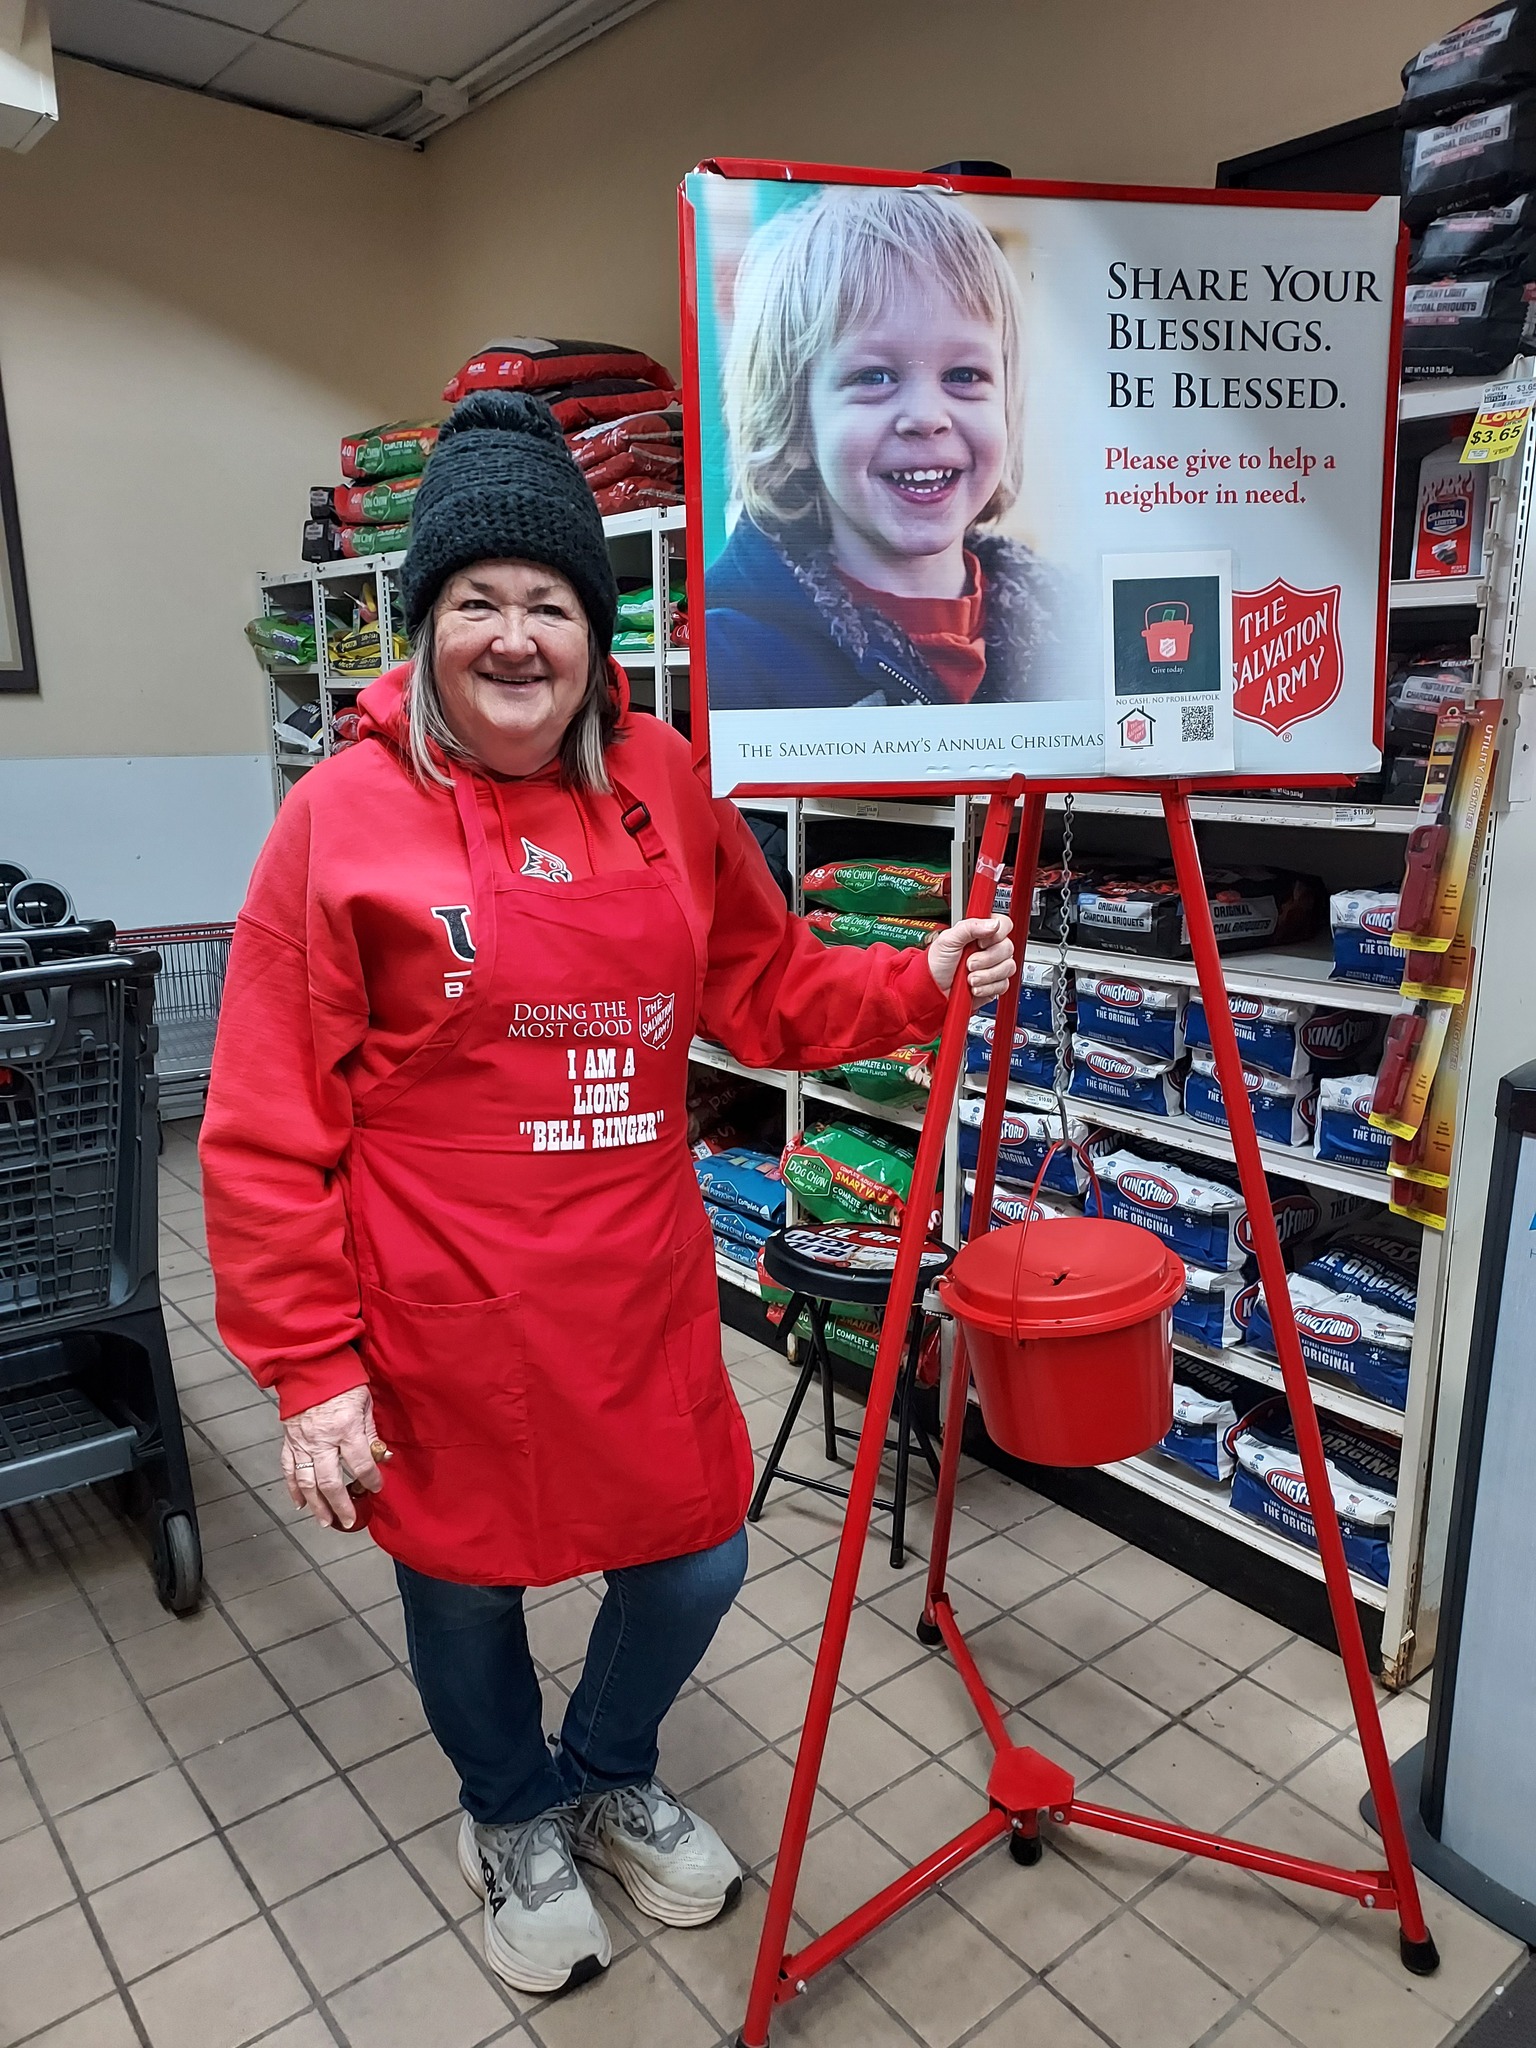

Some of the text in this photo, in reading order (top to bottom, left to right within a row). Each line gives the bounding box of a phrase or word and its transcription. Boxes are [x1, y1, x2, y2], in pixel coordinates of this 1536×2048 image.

[1107, 261, 1383, 303] SHARE YOUR
[1107, 312, 1331, 352] BLESSINGS.
[1107, 371, 1346, 410] BE BLESSED.
[1480, 408, 1527, 424] LOW
[1470, 425, 1522, 446] $3.65
[1105, 446, 1337, 477] Please give to help a
[1105, 480, 1307, 513] neighbor in need.
[1239, 595, 1288, 645] THE
[1151, 666, 1166, 675] Give
[1260, 645, 1325, 716] ARMY
[738, 733, 1104, 759] THE SALVATION ARMY'S ANNUAL CHRISTMAS
[1464, 724, 1494, 830] UTILITY LIGHTER
[1098, 902, 1128, 914] ORIGINAL
[1213, 904, 1252, 919] ORIGINAL
[908, 918, 938, 929] VALUE
[1083, 912, 1145, 928] CHARCOAL BRIQUETS
[1099, 983, 1140, 1002] KINGSFORD
[513, 1000, 627, 1022] DOING THE
[645, 998, 663, 1018] THE
[1095, 1008, 1140, 1027] THE ORIGINAL
[507, 1018, 632, 1038] MOST GOOD
[653, 1015, 672, 1045] ARMY
[567, 1047, 635, 1080] I AM A
[1090, 1054, 1132, 1074] KINGSFORD
[573, 1081, 630, 1115] LIONS
[1085, 1077, 1131, 1098] THE ORIGINAL
[1207, 1089, 1220, 1104] THE
[519, 1109, 665, 1152] "BELL RINGER"
[1352, 1128, 1369, 1142] THE
[788, 1159, 806, 1178] DOG
[806, 1170, 830, 1189] CHOW
[835, 1171, 866, 1194] SMART
[1121, 1176, 1174, 1204] KINGSFORD
[1112, 1204, 1175, 1238] THE ORIGINAL
[745, 1233, 766, 1246] Complet
[1342, 1259, 1417, 1304] ORIGINA
[925, 1310, 950, 1320] Master
[836, 1328, 869, 1348] COMPLETE
[1302, 1345, 1357, 1375] ORIGINAL
[1263, 1501, 1280, 1521] THE
